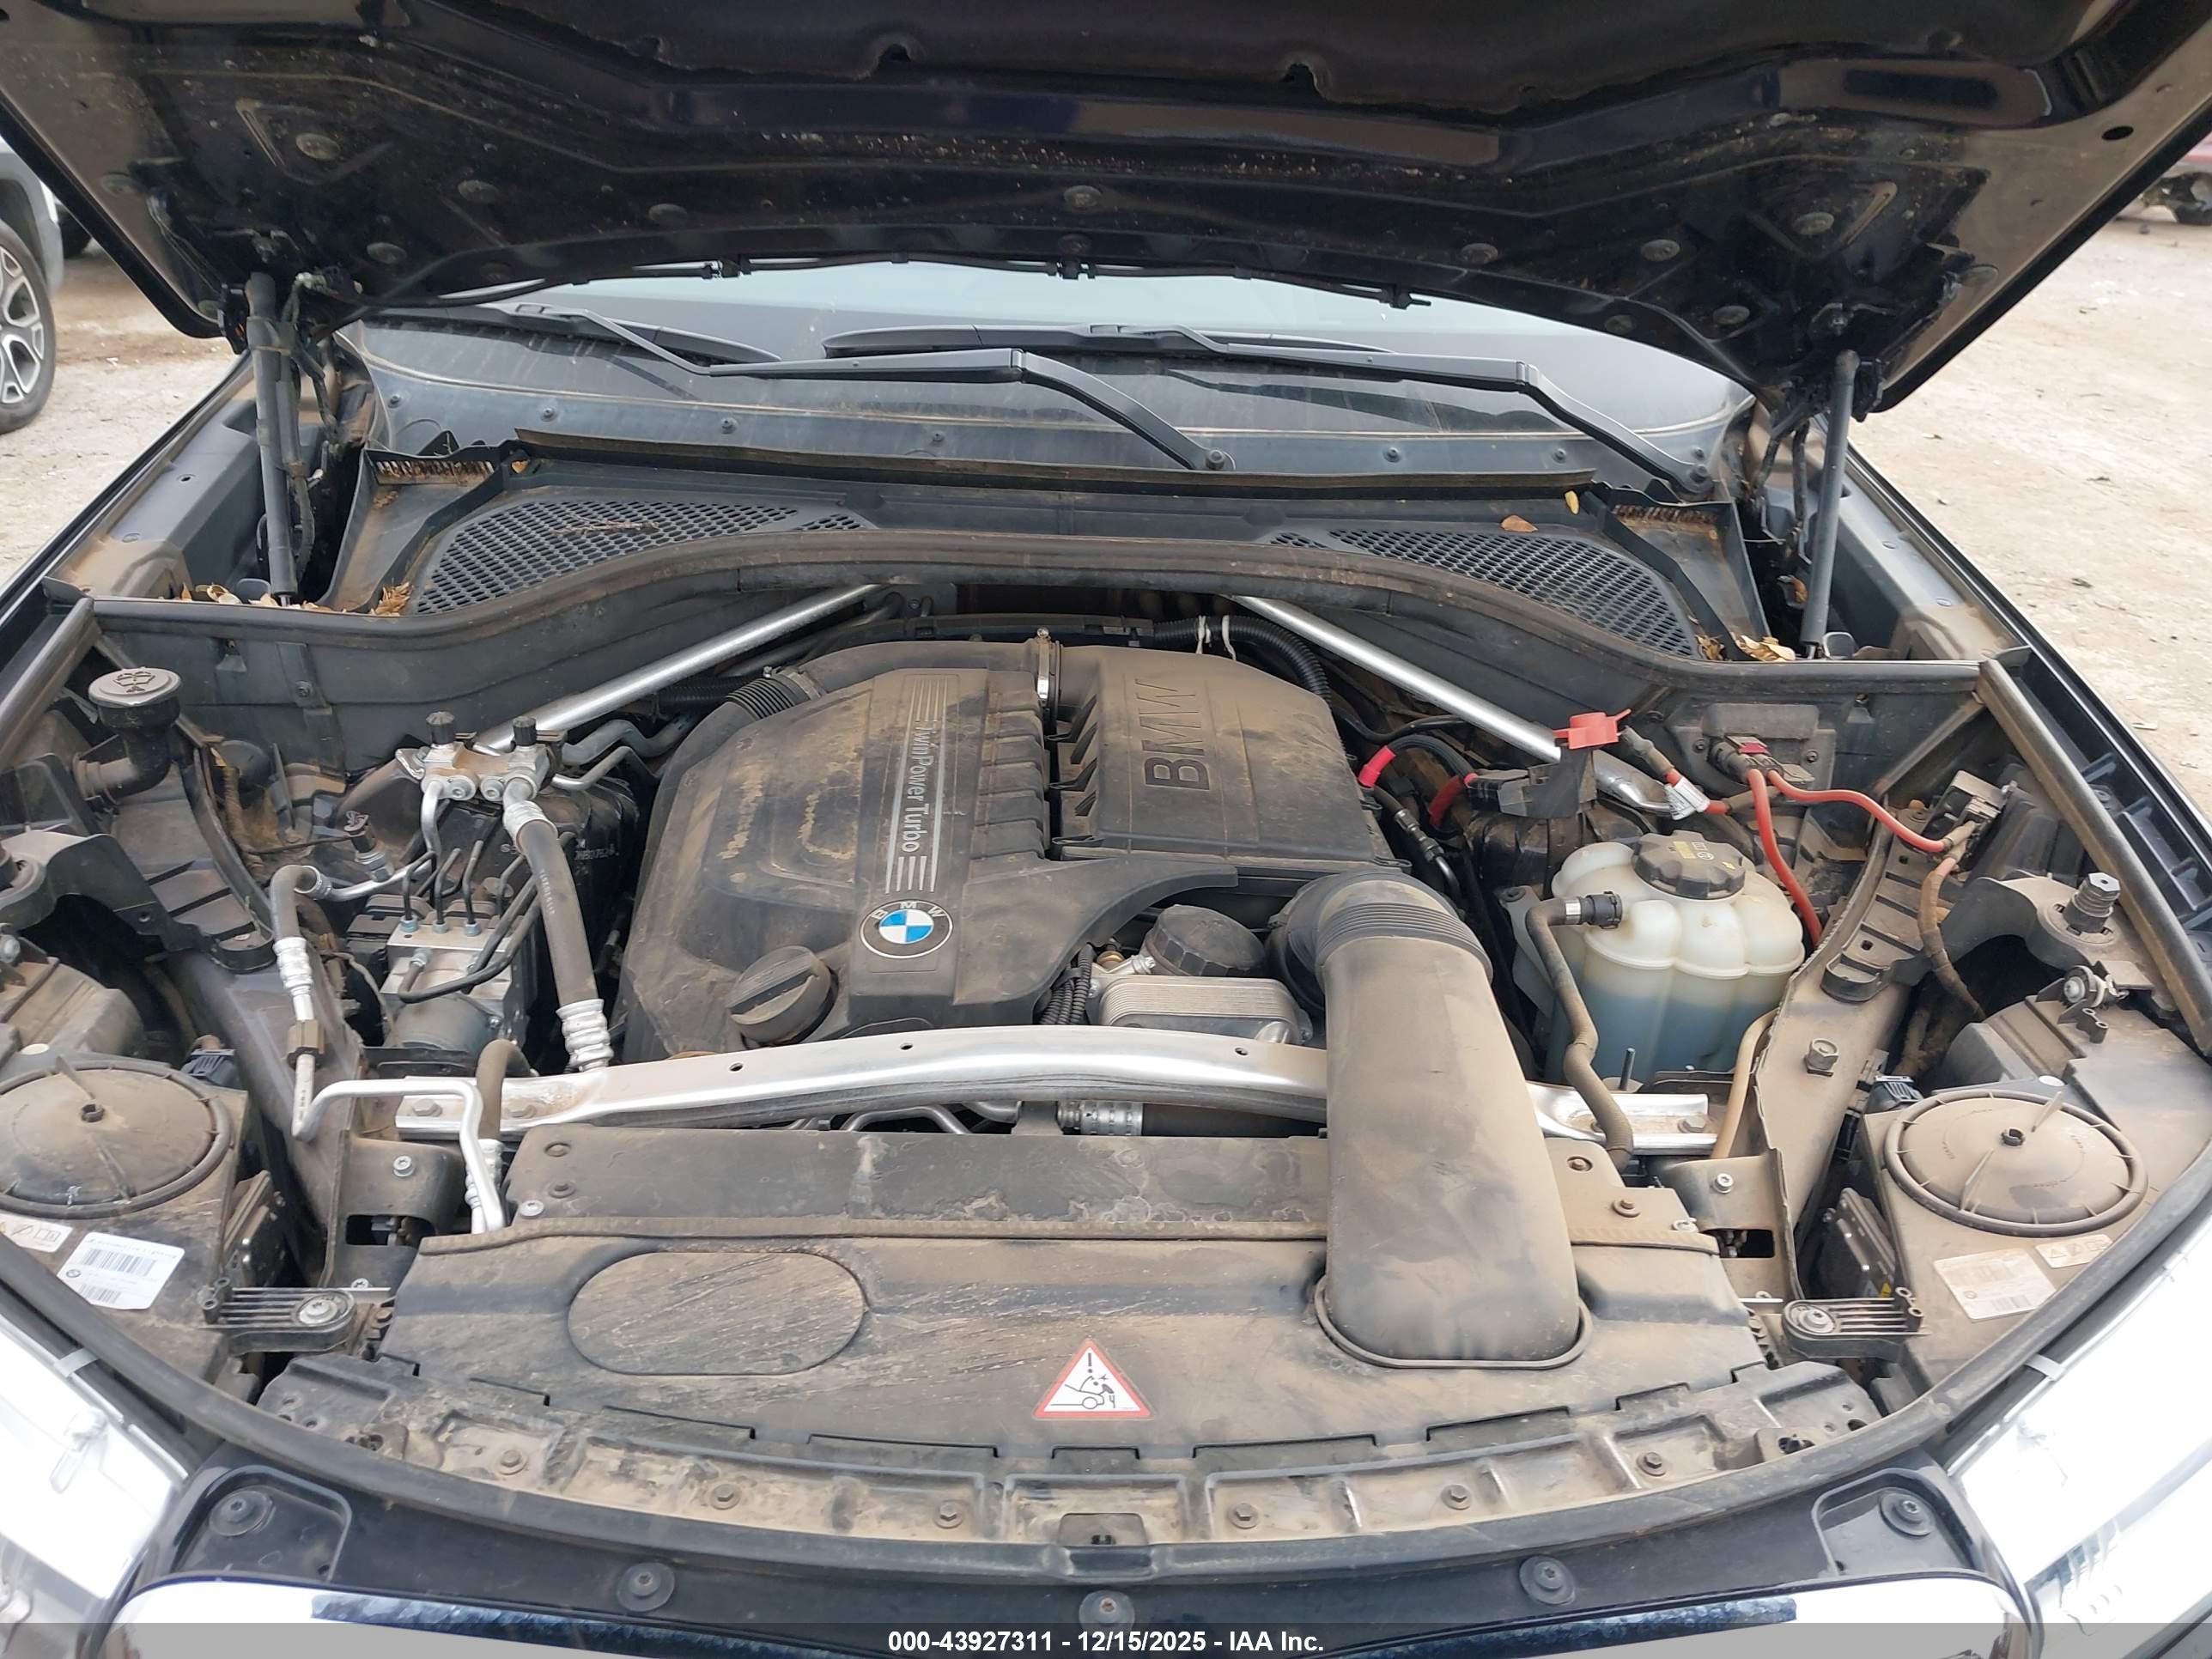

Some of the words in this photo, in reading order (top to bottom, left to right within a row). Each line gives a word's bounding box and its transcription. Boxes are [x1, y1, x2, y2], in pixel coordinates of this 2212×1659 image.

[1134, 678, 1210, 791] BMW
[901, 803, 930, 854] Turbo
[871, 901, 948, 921] BMW
